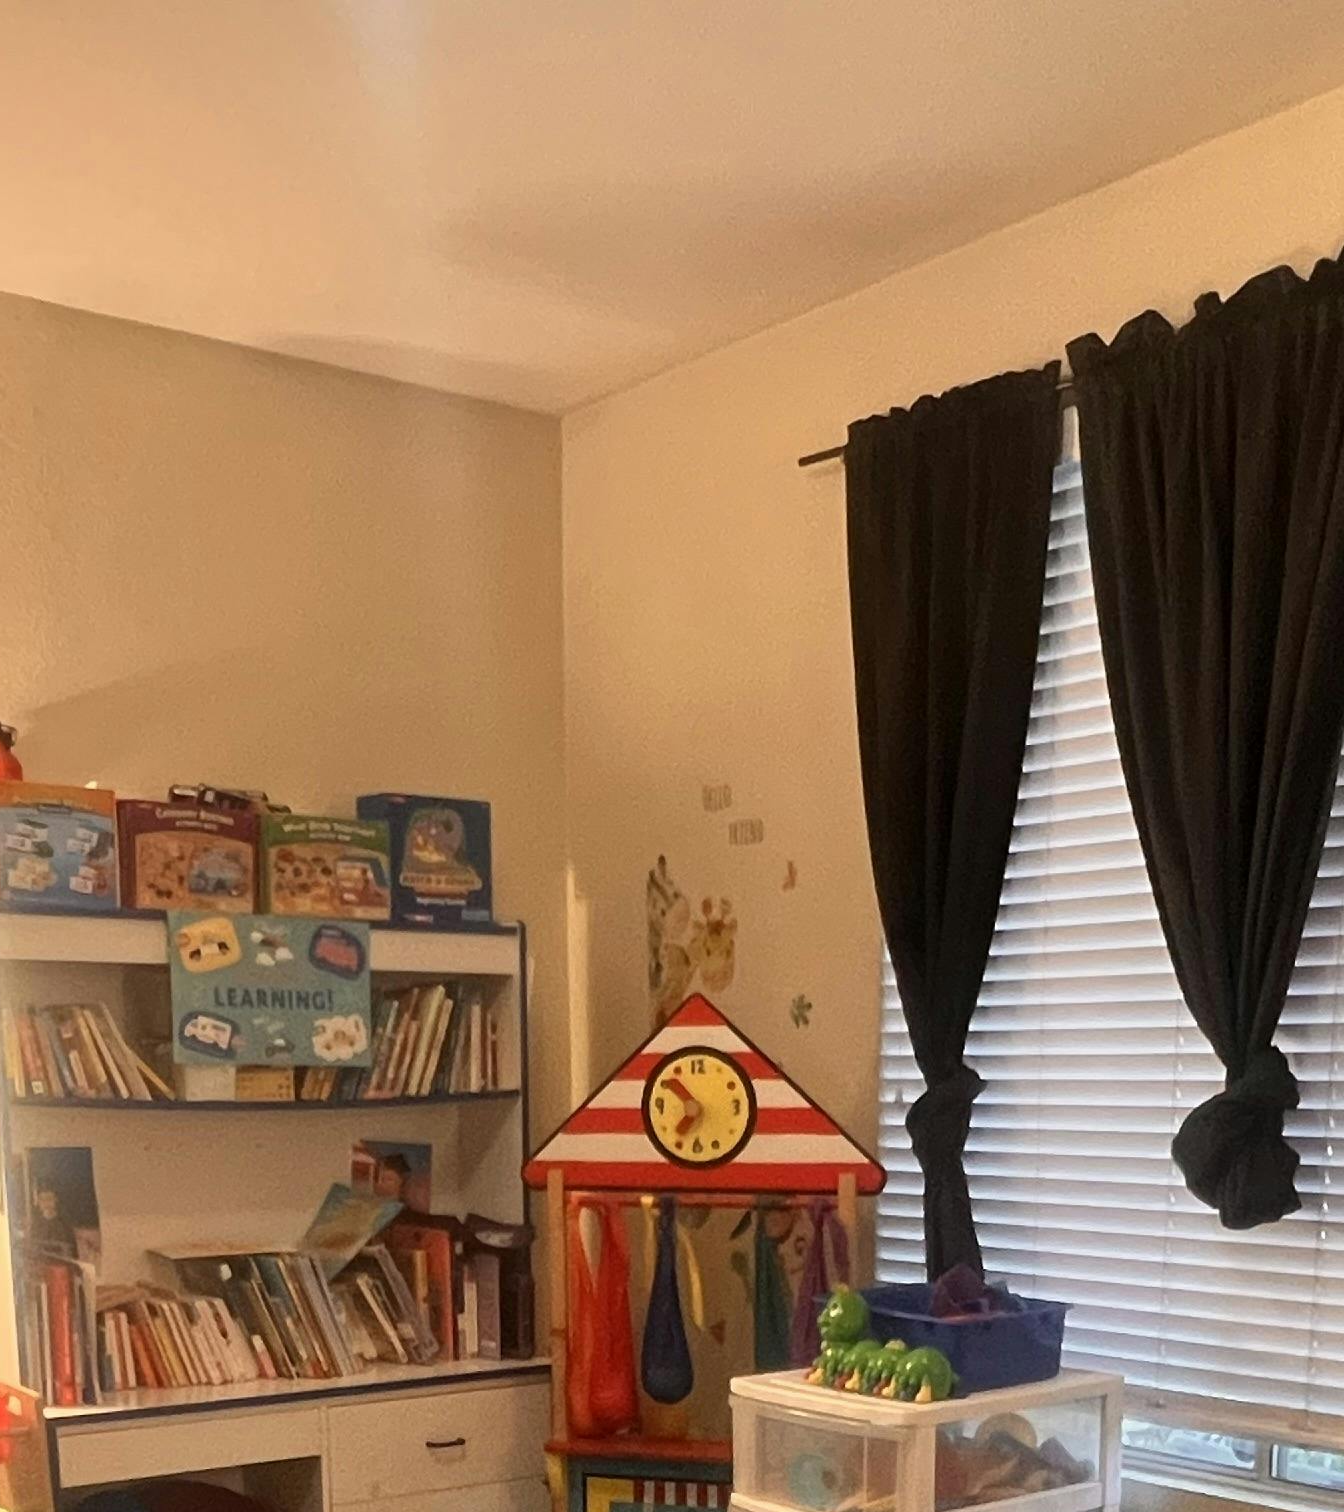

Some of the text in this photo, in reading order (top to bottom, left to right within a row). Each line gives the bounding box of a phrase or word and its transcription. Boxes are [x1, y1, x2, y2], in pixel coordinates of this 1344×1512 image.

[213, 986, 335, 1012] LEARNING!
[690, 1059, 706, 1075] 12
[692, 1137, 703, 1154] 6
